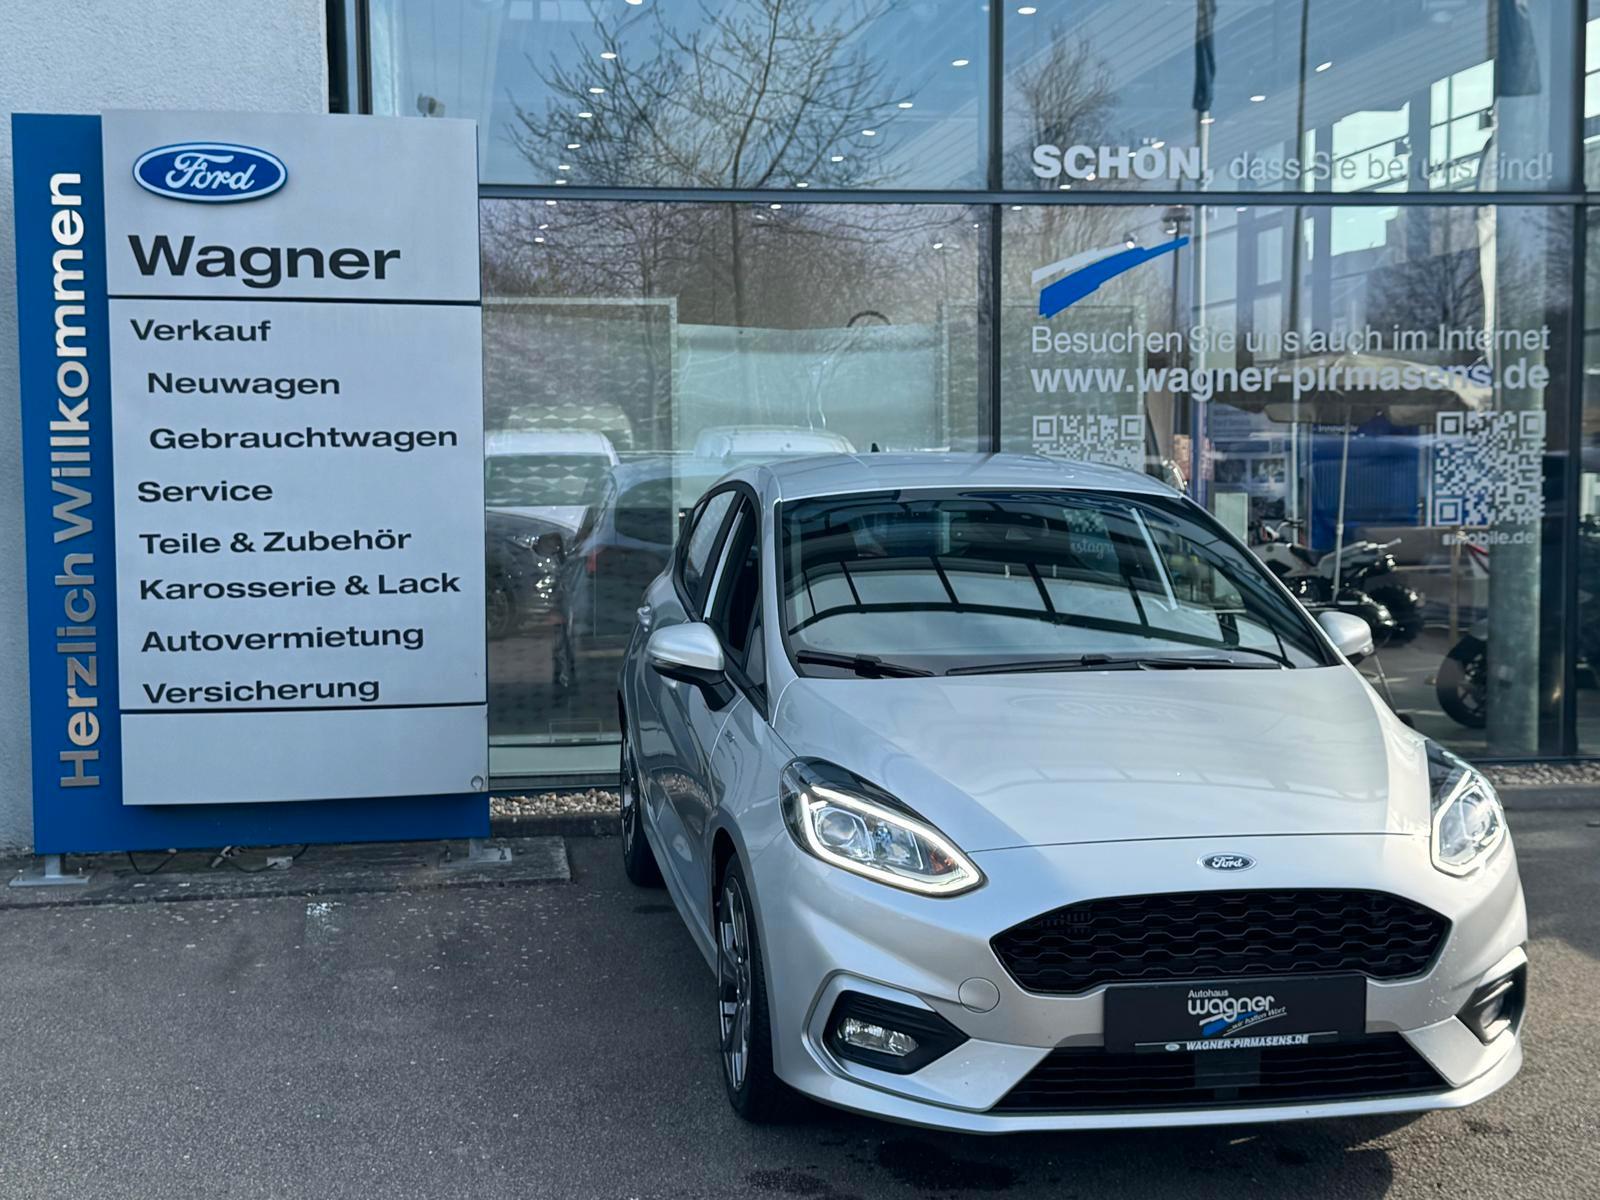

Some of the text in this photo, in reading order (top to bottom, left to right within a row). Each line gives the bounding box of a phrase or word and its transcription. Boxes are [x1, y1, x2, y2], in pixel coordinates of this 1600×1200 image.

[165, 152, 257, 190] Ford
[1032, 137, 1215, 191] SCHÖN,
[1229, 152, 1301, 180] dass
[1314, 151, 1356, 180] Sie
[1368, 153, 1410, 180] be
[128, 235, 401, 289] Wagner
[130, 319, 272, 342] Verkauf
[1031, 324, 1551, 353] Besuchen Sie uns auch im Internet
[147, 373, 340, 400] Neuwagen
[1031, 357, 1550, 401] www.wagner-pirmasens.de
[149, 427, 458, 452] Gebrauchtwagen
[50, 172, 100, 788] Herzlich Willkommen
[137, 481, 273, 502] Service
[139, 529, 412, 555] Teile & Zubehör
[140, 573, 461, 600] Karosserie & Lack
[141, 626, 424, 653] Autovermietung
[142, 680, 380, 703] Versicherung
[1212, 856, 1244, 868] Ford
[1188, 989, 1229, 998] Autohaus
[1187, 995, 1275, 1022] wagner
[1186, 1034, 1309, 1051] WAGNER-PIRMASENS.DE
